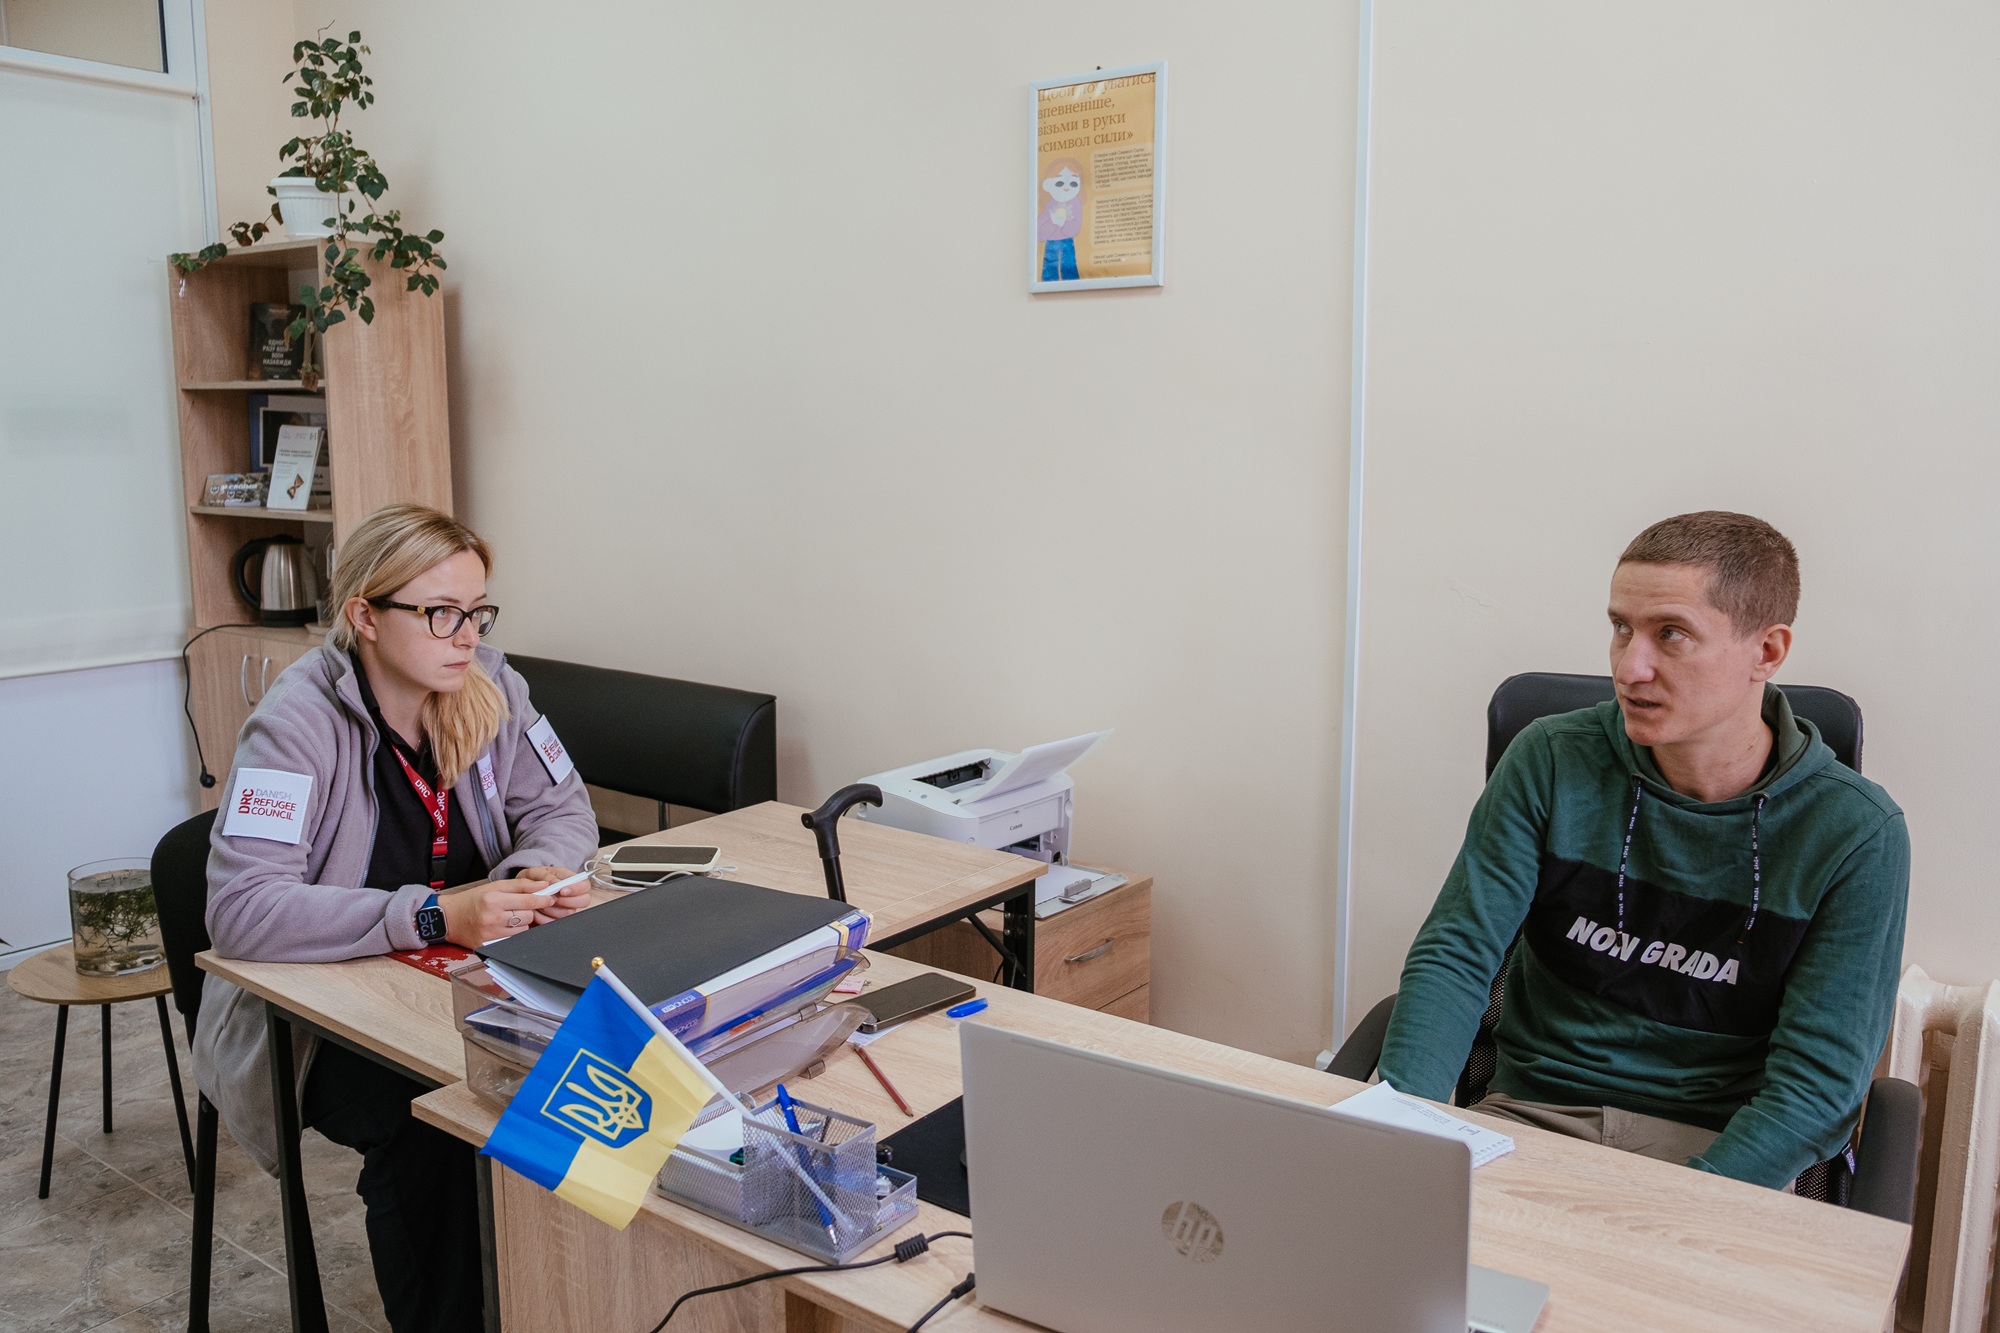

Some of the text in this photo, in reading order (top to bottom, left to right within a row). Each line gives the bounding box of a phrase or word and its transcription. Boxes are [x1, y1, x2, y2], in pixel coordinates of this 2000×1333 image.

[1082, 119, 1090, 129] в
[1093, 113, 1126, 131] руки
[1094, 130, 1134, 145] сили»
[255, 788, 292, 799] DANISH
[415, 779, 431, 798] DRC
[238, 788, 255, 815] DRC
[253, 797, 297, 811] REFUGEE
[251, 806, 294, 821] COUNCIL
[433, 809, 446, 828] DRC
[420, 924, 437, 937] 13
[1566, 916, 1740, 985] NON GRADA
[1167, 1200, 1220, 1261] hp
